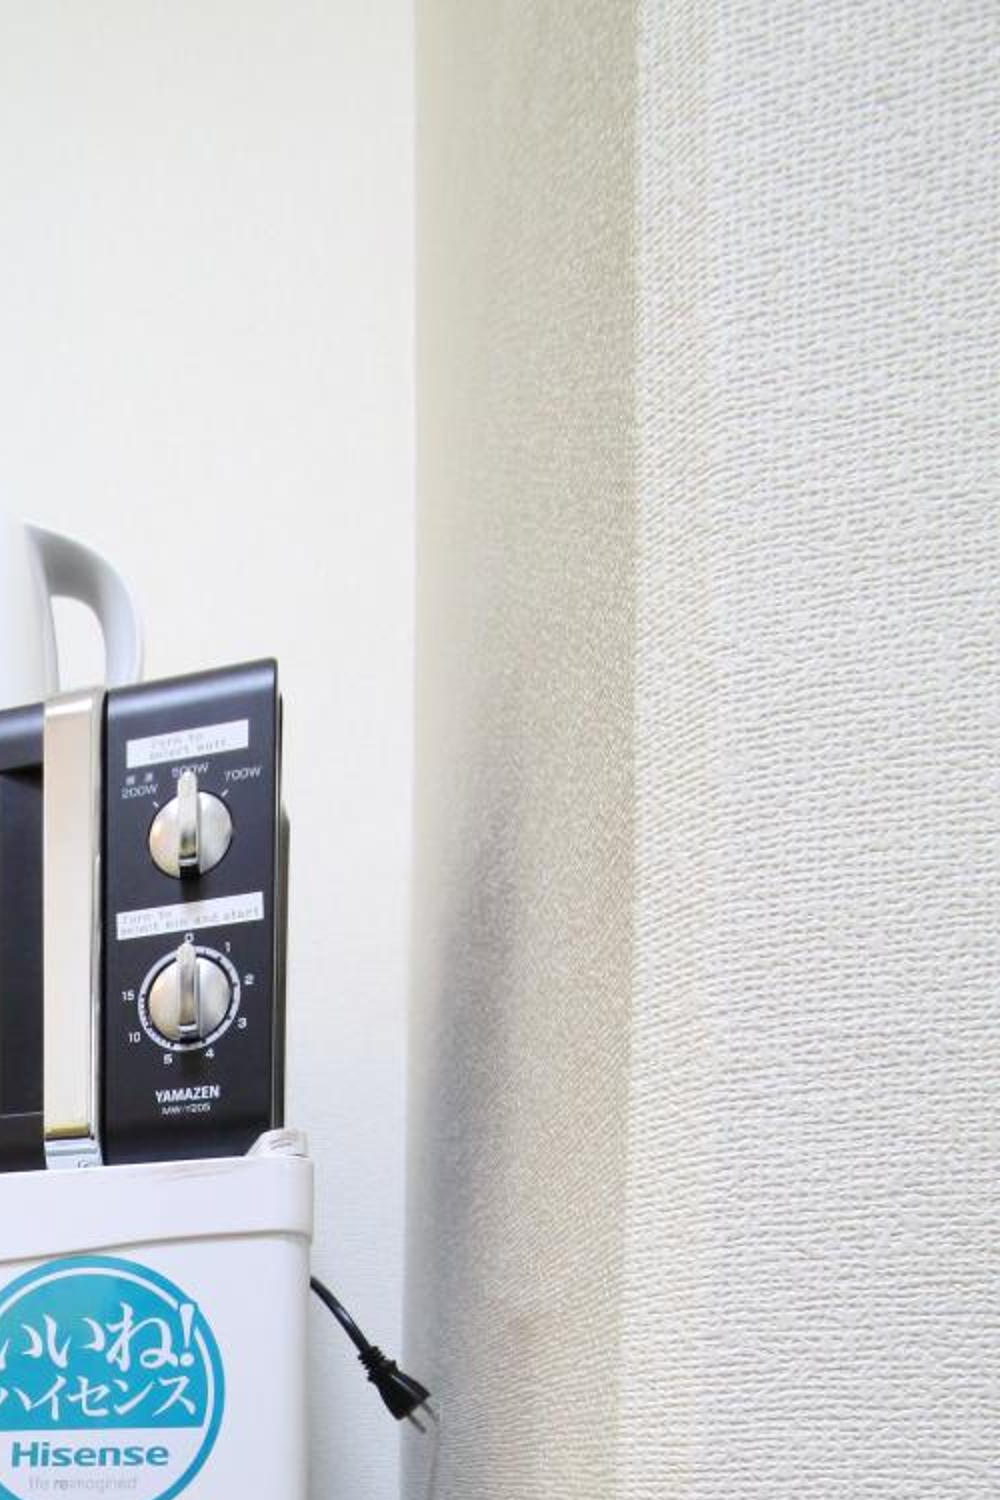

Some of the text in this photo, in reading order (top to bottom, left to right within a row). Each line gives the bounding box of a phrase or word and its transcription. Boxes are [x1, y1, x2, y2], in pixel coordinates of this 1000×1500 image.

[224, 766, 262, 782] 700W
[121, 783, 158, 799] 200W
[225, 942, 232, 952] 1
[244, 974, 255, 985] 2
[121, 990, 135, 1001] 15
[238, 1017, 248, 1028] 3
[129, 1032, 141, 1043] 10
[163, 1053, 173, 1065] 5
[204, 1048, 215, 1059] 4
[155, 1084, 221, 1103] YAMAZEN
[10, 1441, 169, 1467] Hisense
